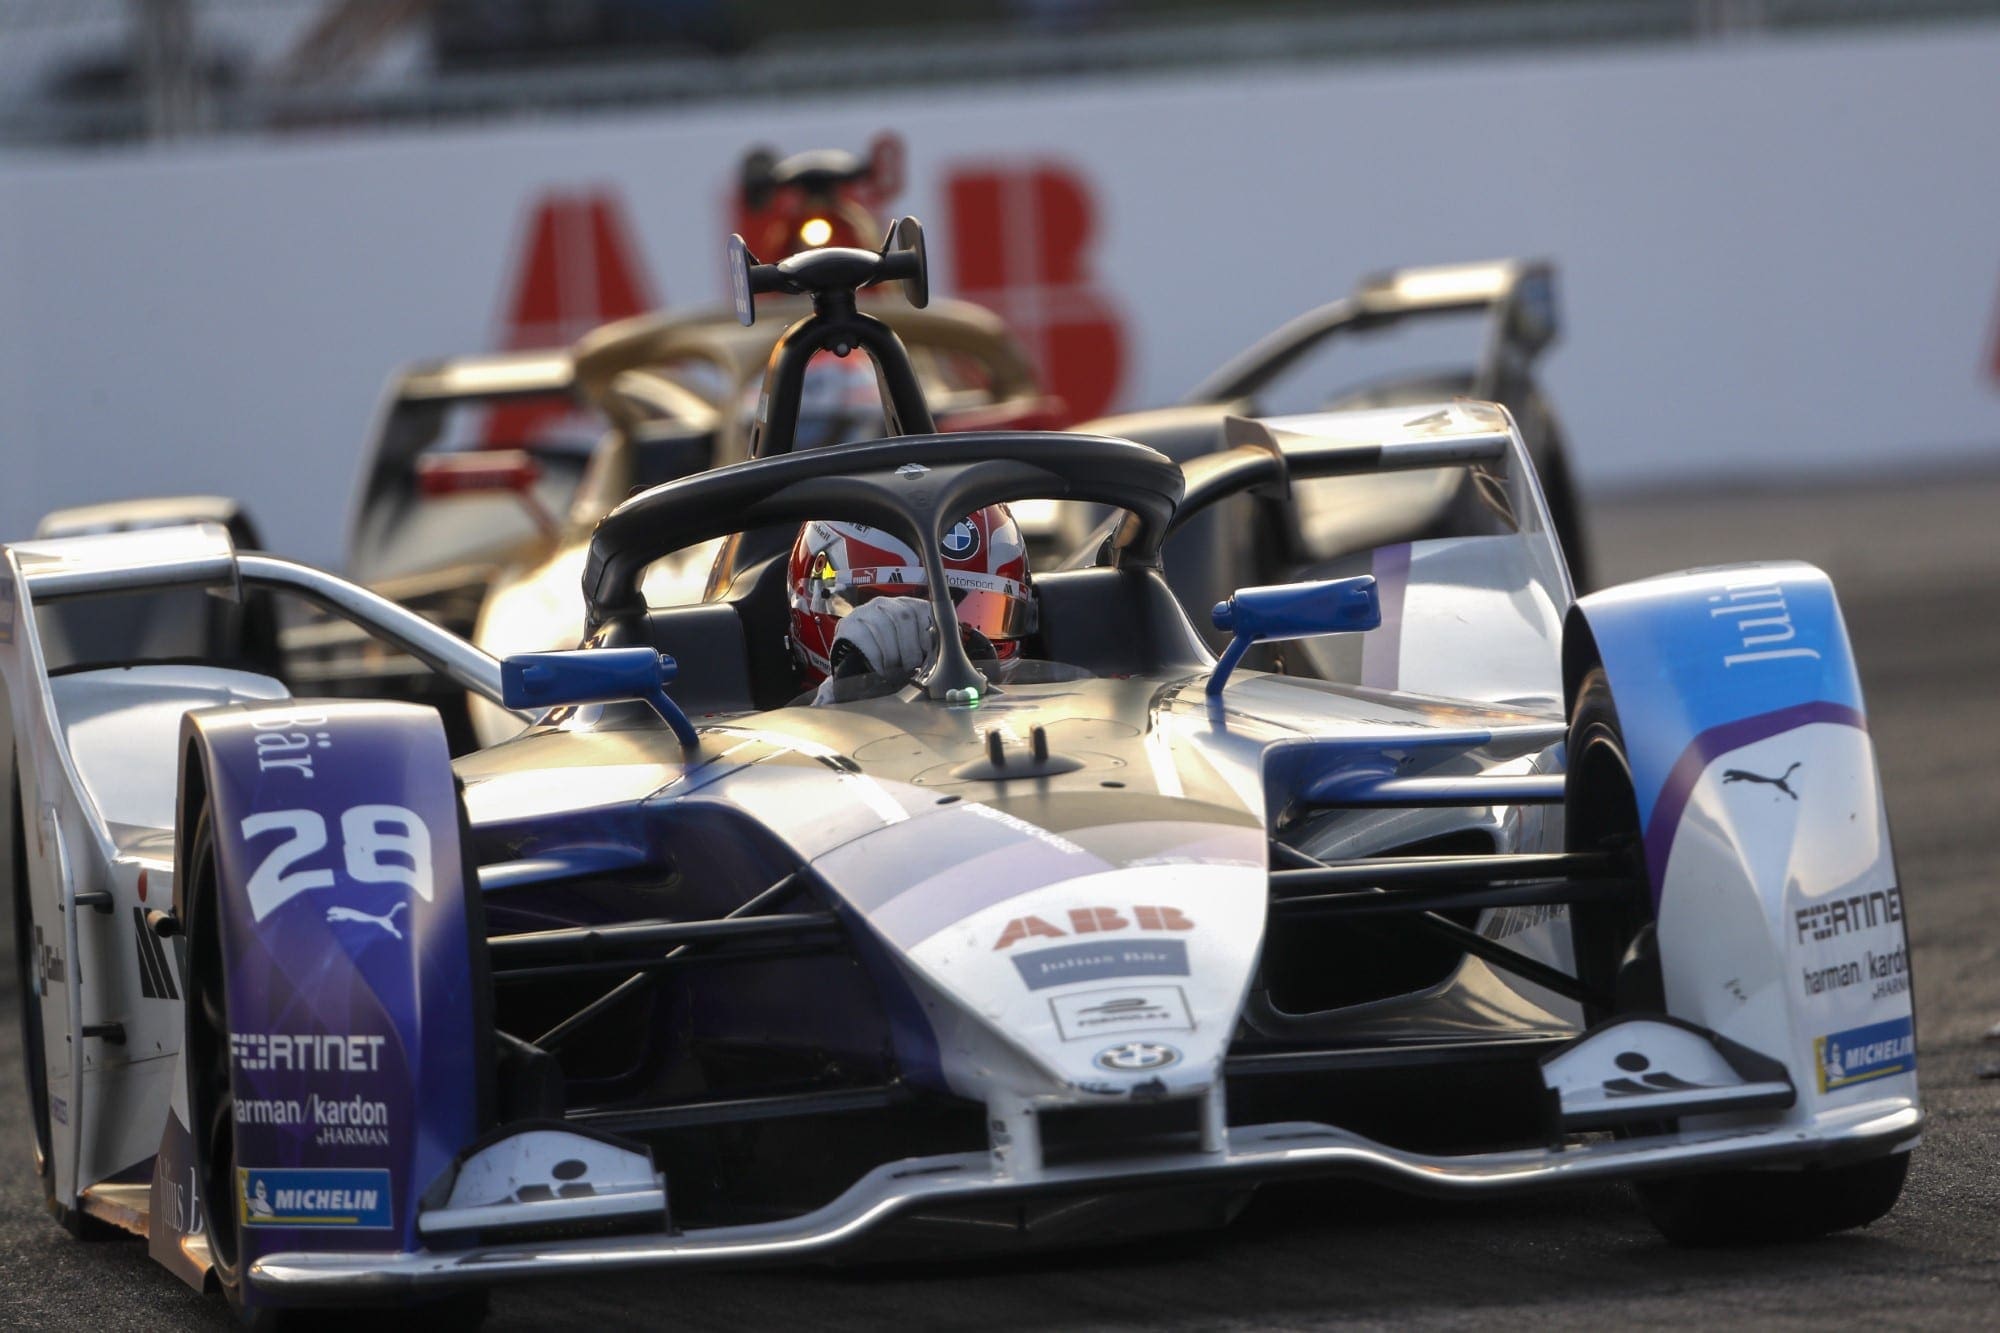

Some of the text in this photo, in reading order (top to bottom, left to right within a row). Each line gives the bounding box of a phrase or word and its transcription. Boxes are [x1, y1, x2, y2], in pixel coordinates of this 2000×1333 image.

[240, 804, 434, 924] 28
[992, 906, 1195, 951] ABB
[1796, 887, 1902, 945] FORTINE
[230, 1033, 385, 1072] FORTINET
[323, 1127, 389, 1145] HARMAN
[275, 1189, 378, 1210] MICHELIN
